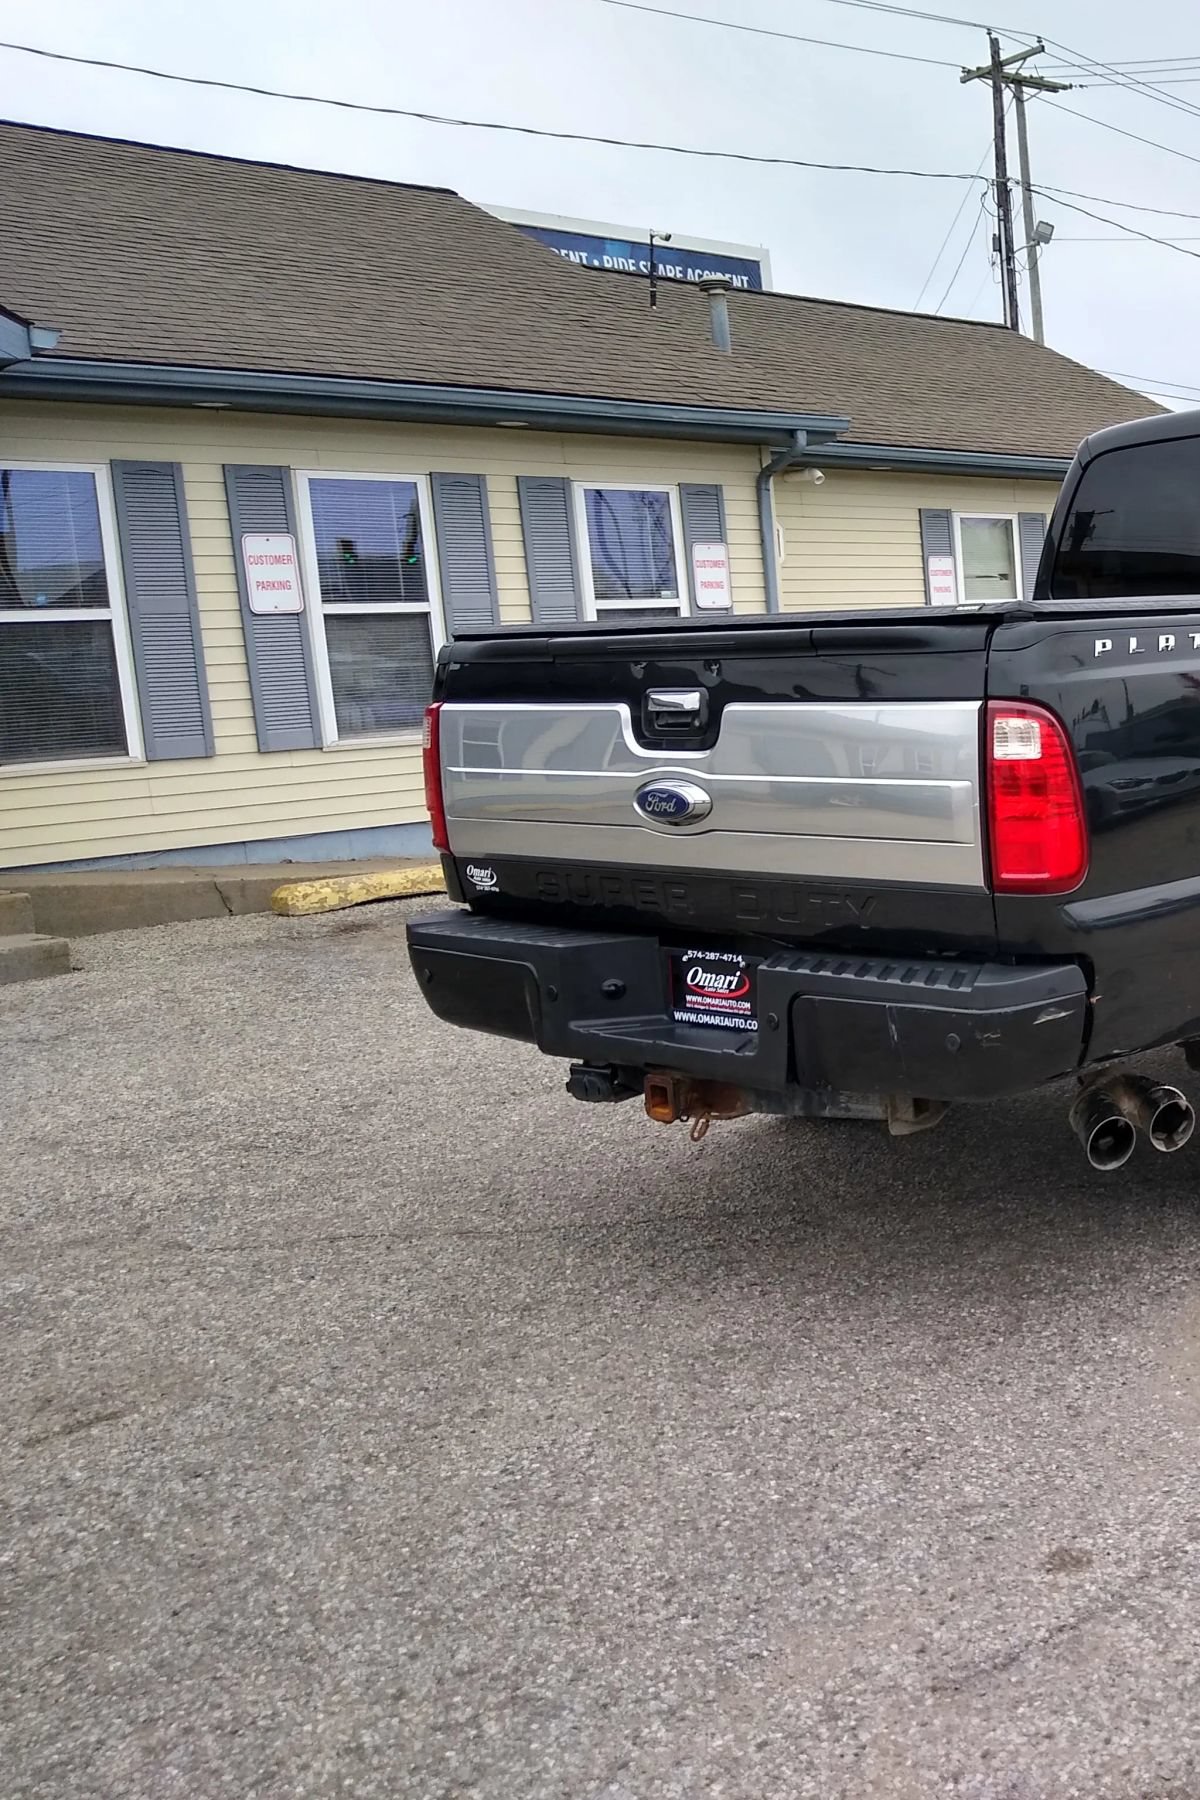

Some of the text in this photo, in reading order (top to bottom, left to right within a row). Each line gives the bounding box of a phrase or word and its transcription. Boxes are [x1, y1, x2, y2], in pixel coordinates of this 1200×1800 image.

[248, 554, 293, 566] CUSTOMER
[255, 579, 292, 592] PARKING
[645, 791, 677, 813] Ford
[466, 864, 492, 878] Omari
[535, 871, 879, 929] SUPER DUTY
[687, 950, 743, 963] 574-287-4714
[686, 966, 741, 990] Omari
[685, 995, 751, 1010] WWW.OMARIAUTO.COM
